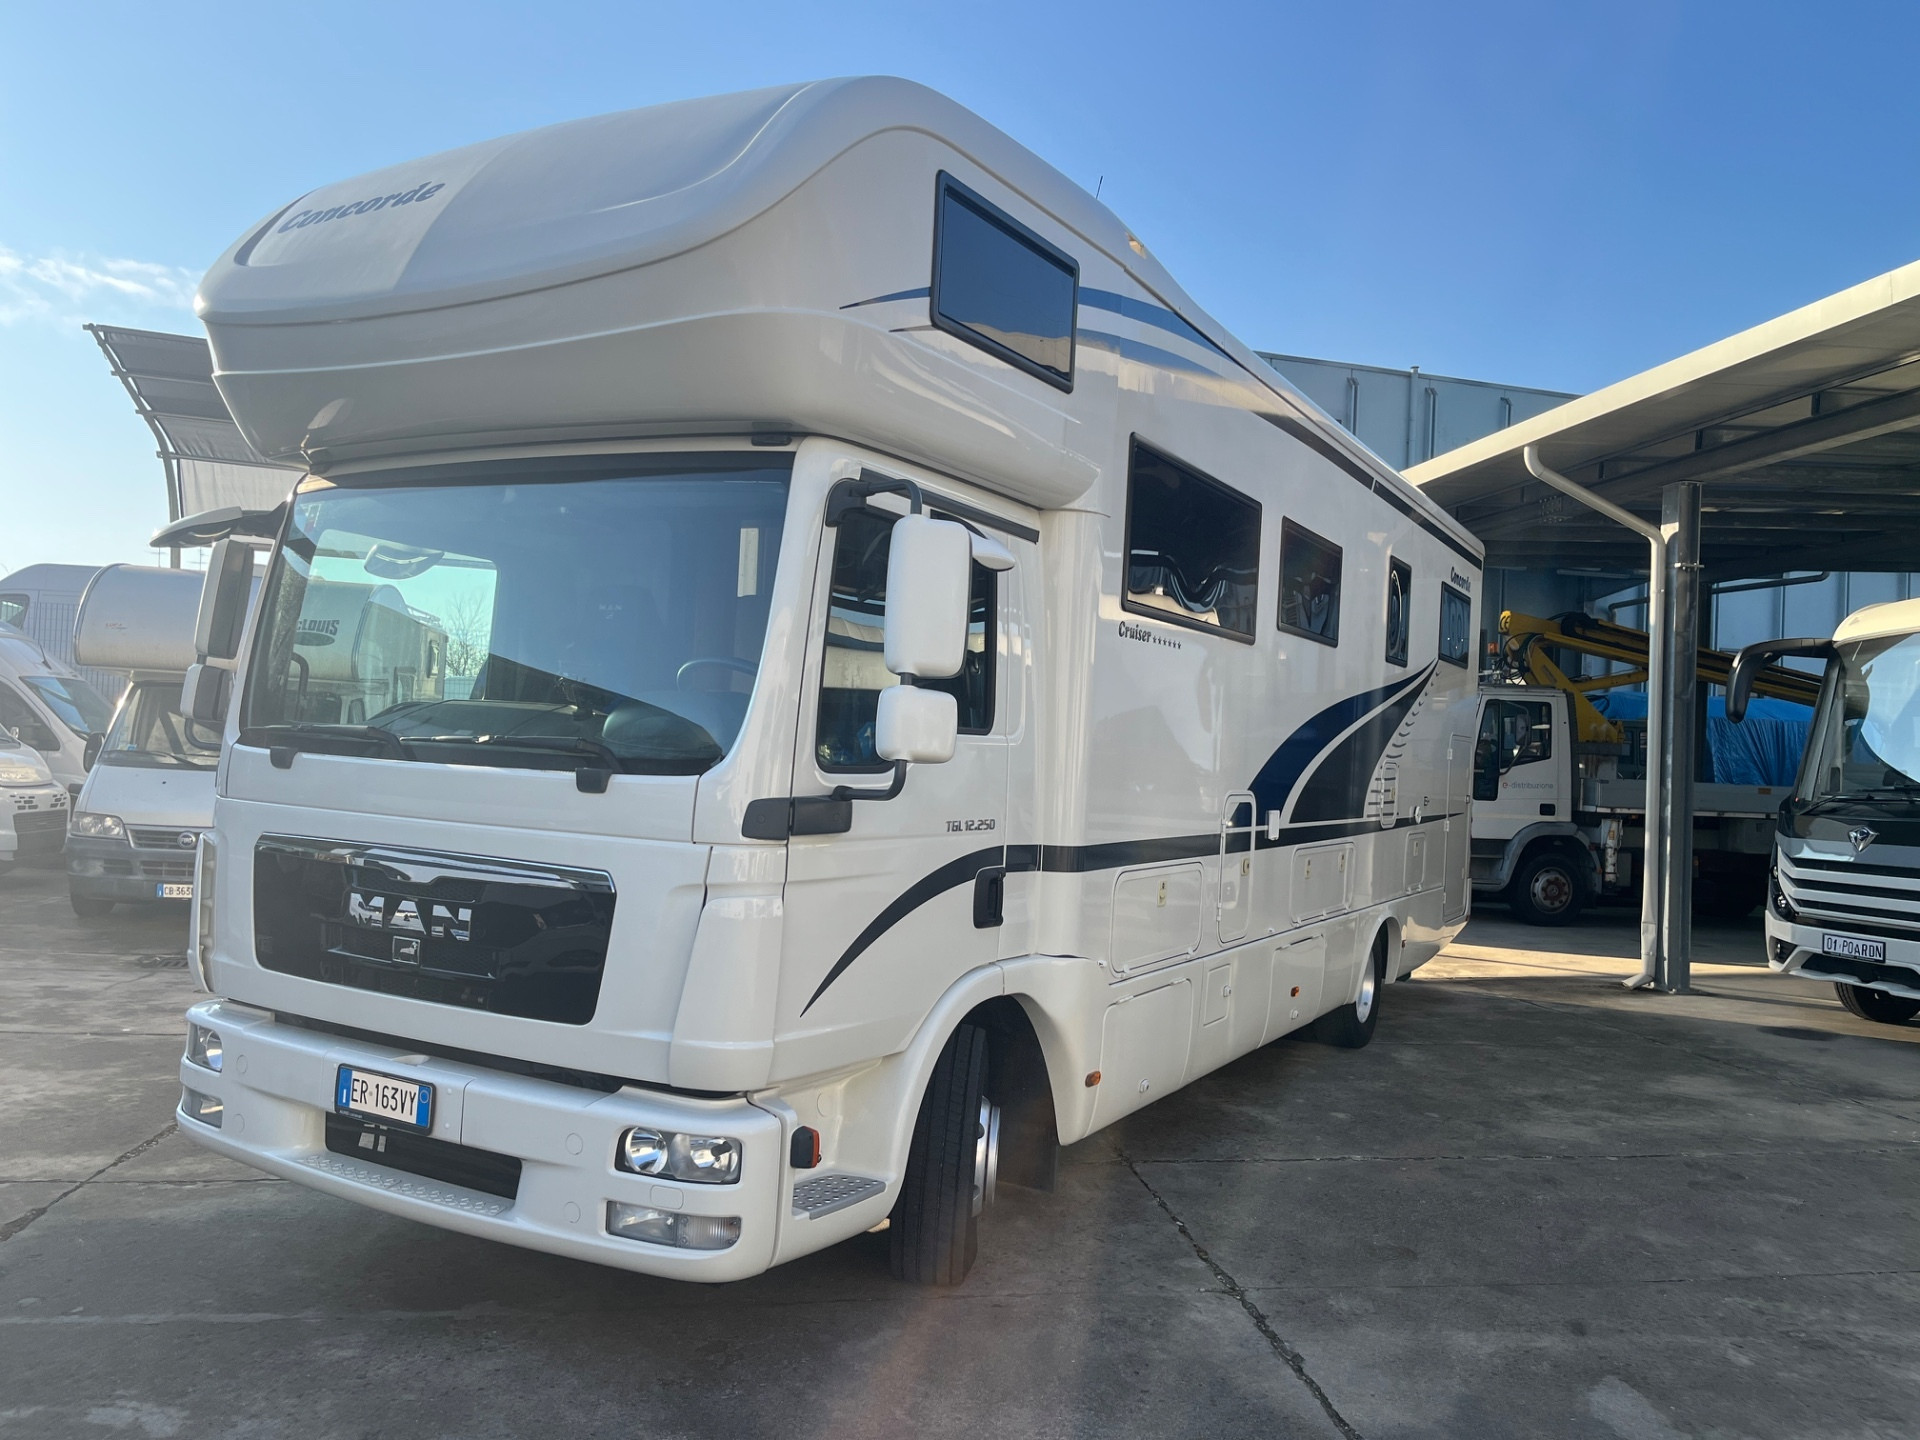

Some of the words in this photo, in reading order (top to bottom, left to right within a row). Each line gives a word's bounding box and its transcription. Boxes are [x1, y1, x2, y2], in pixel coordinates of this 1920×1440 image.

[277, 181, 446, 234] Concorde
[1118, 620, 1152, 643] Cruiser
[1502, 781, 1554, 789] e-distribuzione
[945, 820, 963, 832] TGL
[964, 818, 996, 831] 12.250
[349, 892, 472, 941] MAN
[1826, 937, 1838, 951] 01
[351, 1079, 369, 1104] ER
[374, 1083, 416, 1116] 163VY
